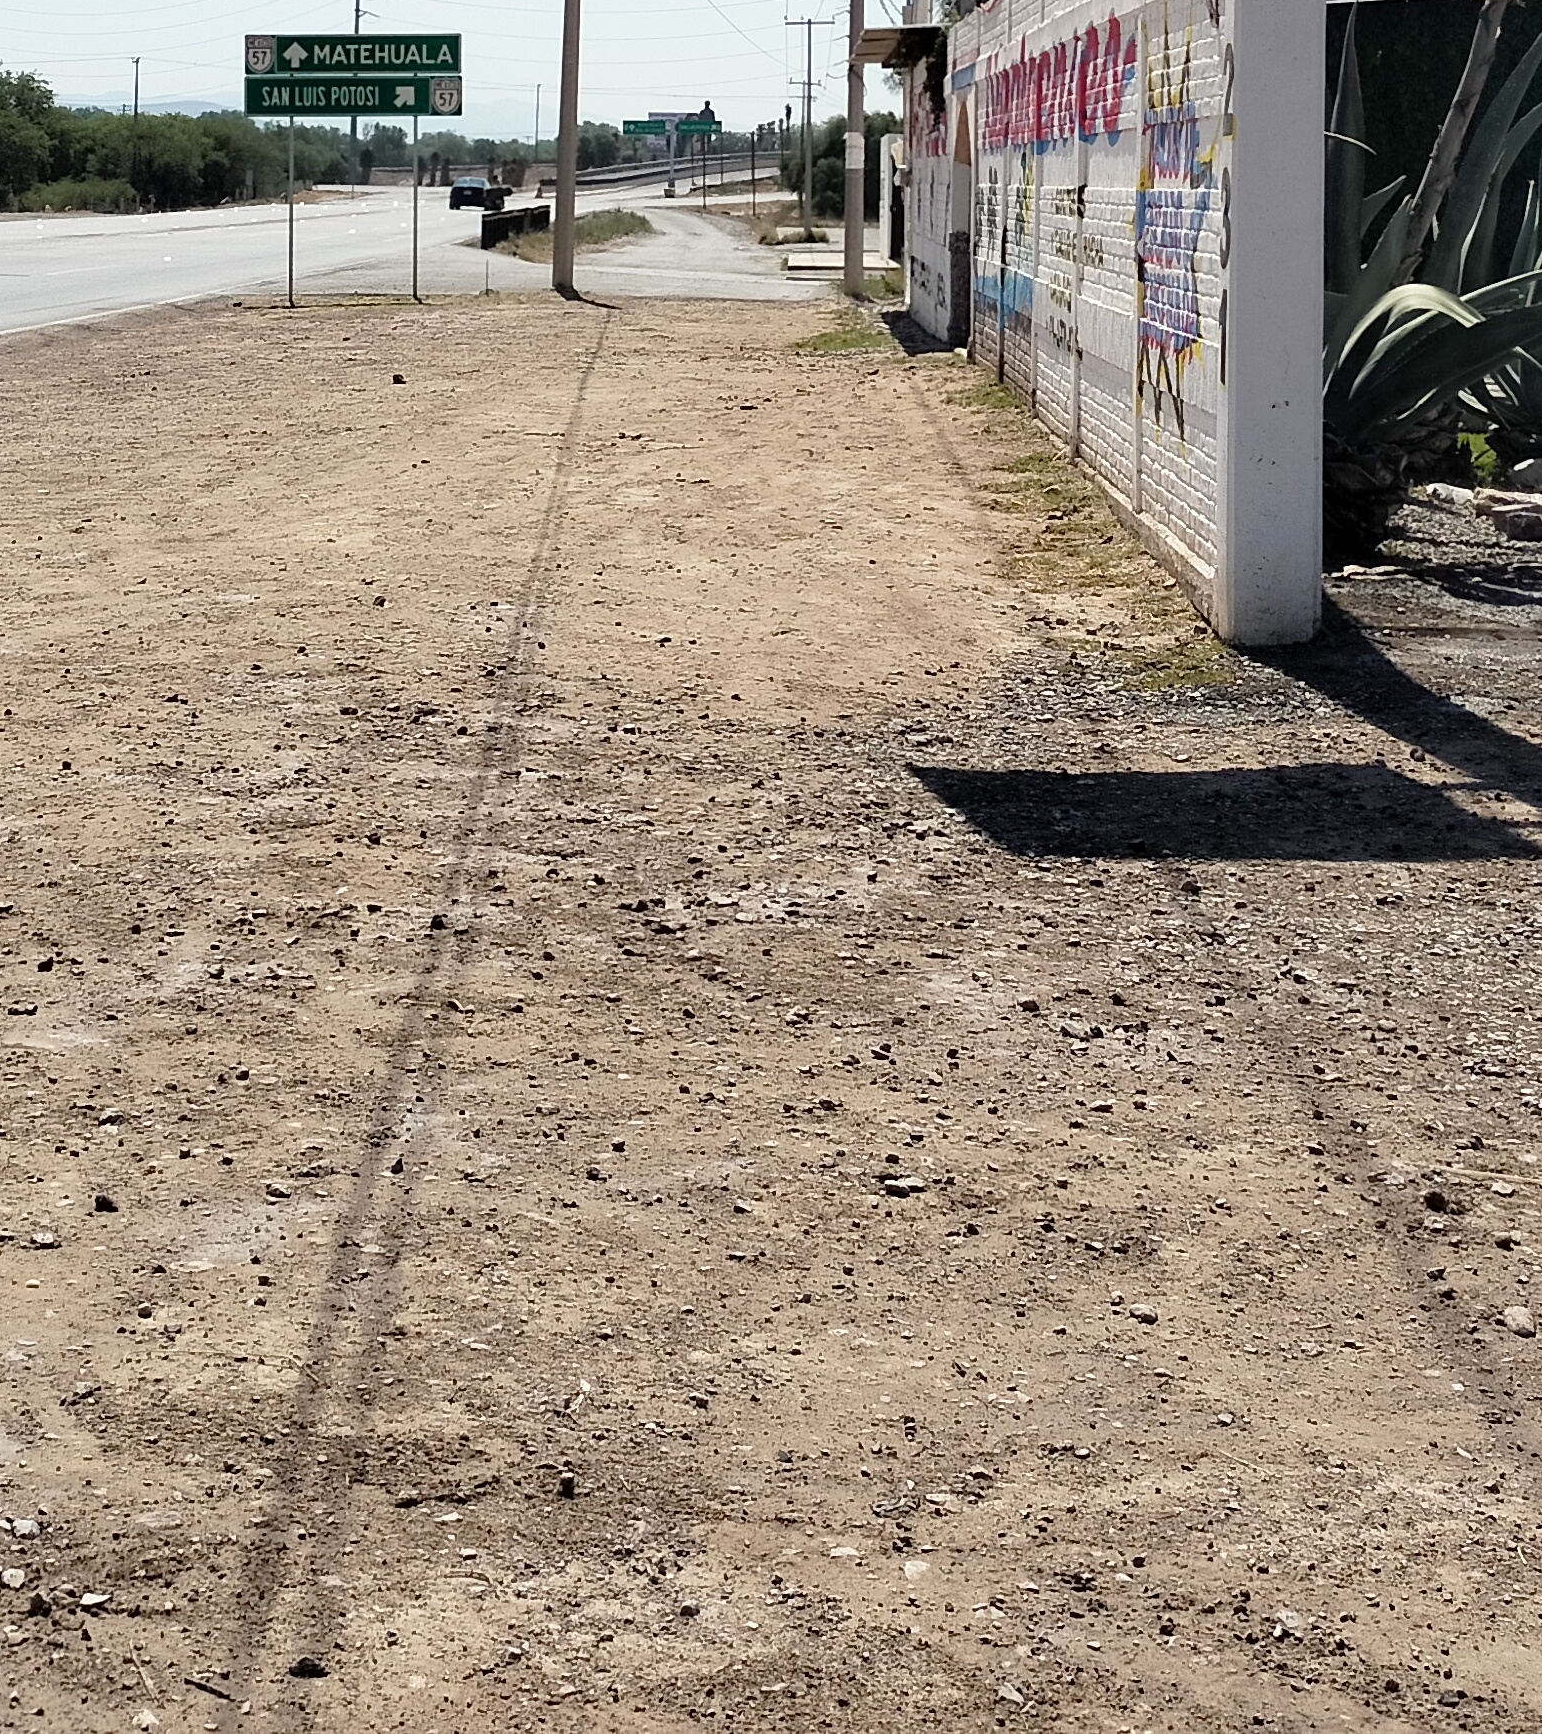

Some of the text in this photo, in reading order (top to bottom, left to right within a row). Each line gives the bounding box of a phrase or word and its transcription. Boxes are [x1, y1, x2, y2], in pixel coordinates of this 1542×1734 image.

[252, 44, 453, 66] 57 MATEHUALA
[262, 86, 454, 107] SAN LUIS POTOSI 57
